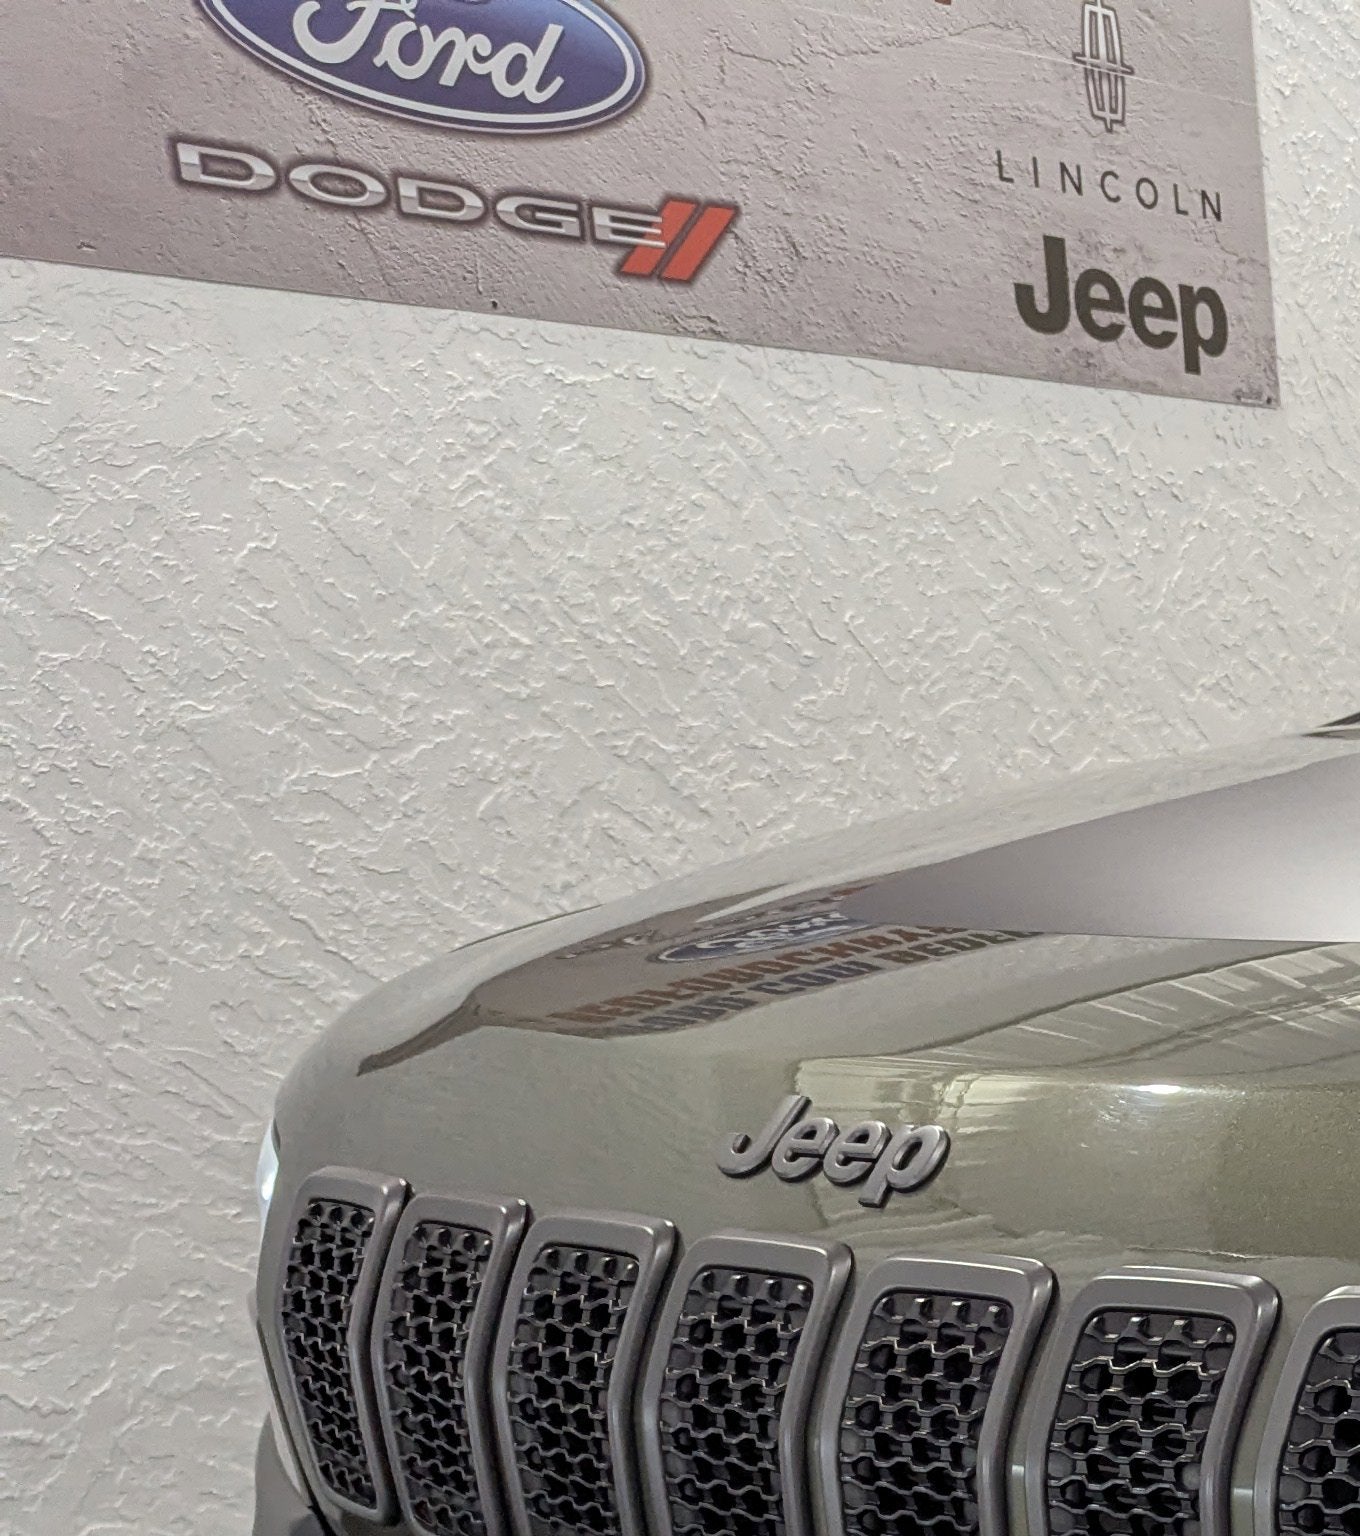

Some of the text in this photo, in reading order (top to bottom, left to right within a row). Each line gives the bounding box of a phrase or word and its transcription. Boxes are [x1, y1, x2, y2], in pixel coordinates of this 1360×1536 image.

[292, 0, 565, 104] Ford
[176, 142, 667, 250] DODGE
[996, 149, 1222, 222] LINCOLN
[1013, 235, 1229, 376] Jeep
[716, 1094, 953, 1209] Jeep
